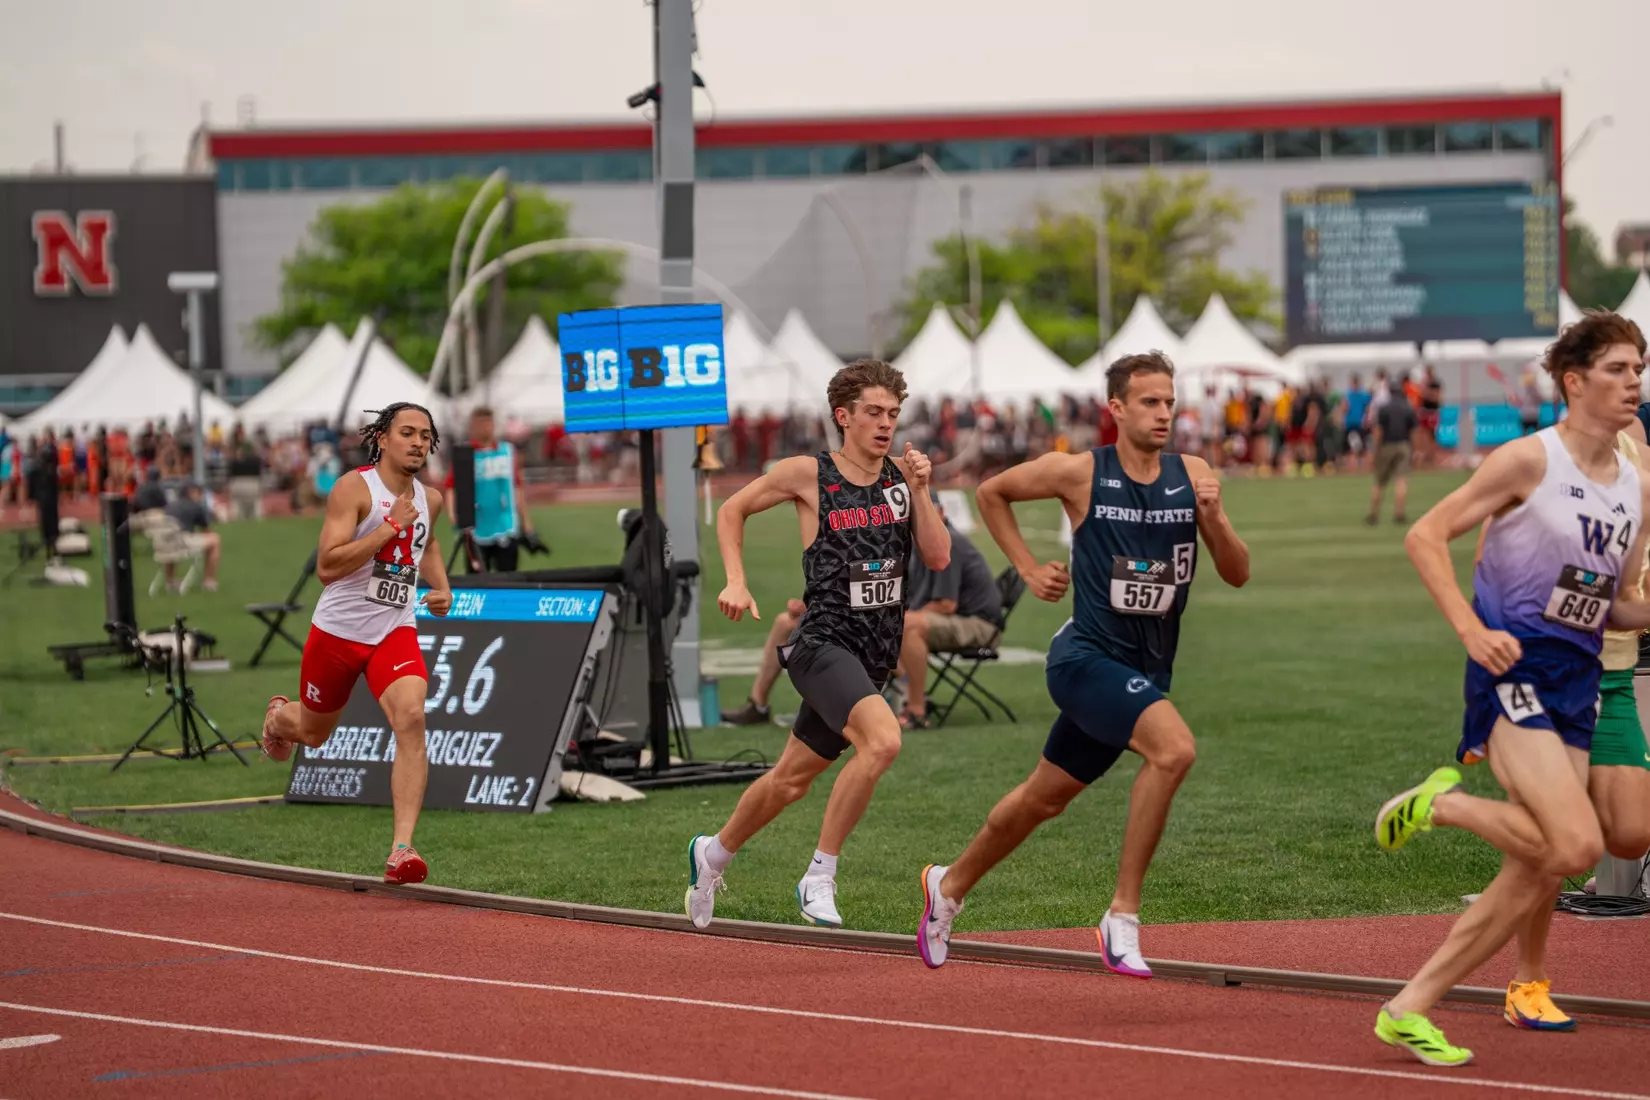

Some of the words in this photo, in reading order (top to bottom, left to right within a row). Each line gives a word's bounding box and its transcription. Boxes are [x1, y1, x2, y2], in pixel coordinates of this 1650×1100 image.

[31, 209, 119, 297] N
[890, 487, 907, 517] 9
[1094, 504, 1143, 523] PENN
[1145, 508, 1193, 524] STATE
[829, 507, 868, 531] OHIO
[413, 522, 426, 549] 2
[1577, 512, 1614, 556] W
[1616, 519, 1632, 556] 4
[1177, 546, 1189, 580] 5
[376, 580, 409, 604] 603
[454, 592, 487, 616] RUN
[861, 580, 895, 605] 502
[1123, 583, 1165, 609] 557
[535, 597, 586, 617] SECTION:
[587, 597, 597, 616] 4
[1558, 593, 1600, 625] 649
[305, 681, 322, 703] R
[1511, 683, 1533, 712] 4
[288, 765, 368, 798] RUTGERS
[465, 774, 520, 806] LANE:
[518, 776, 537, 807] 2
